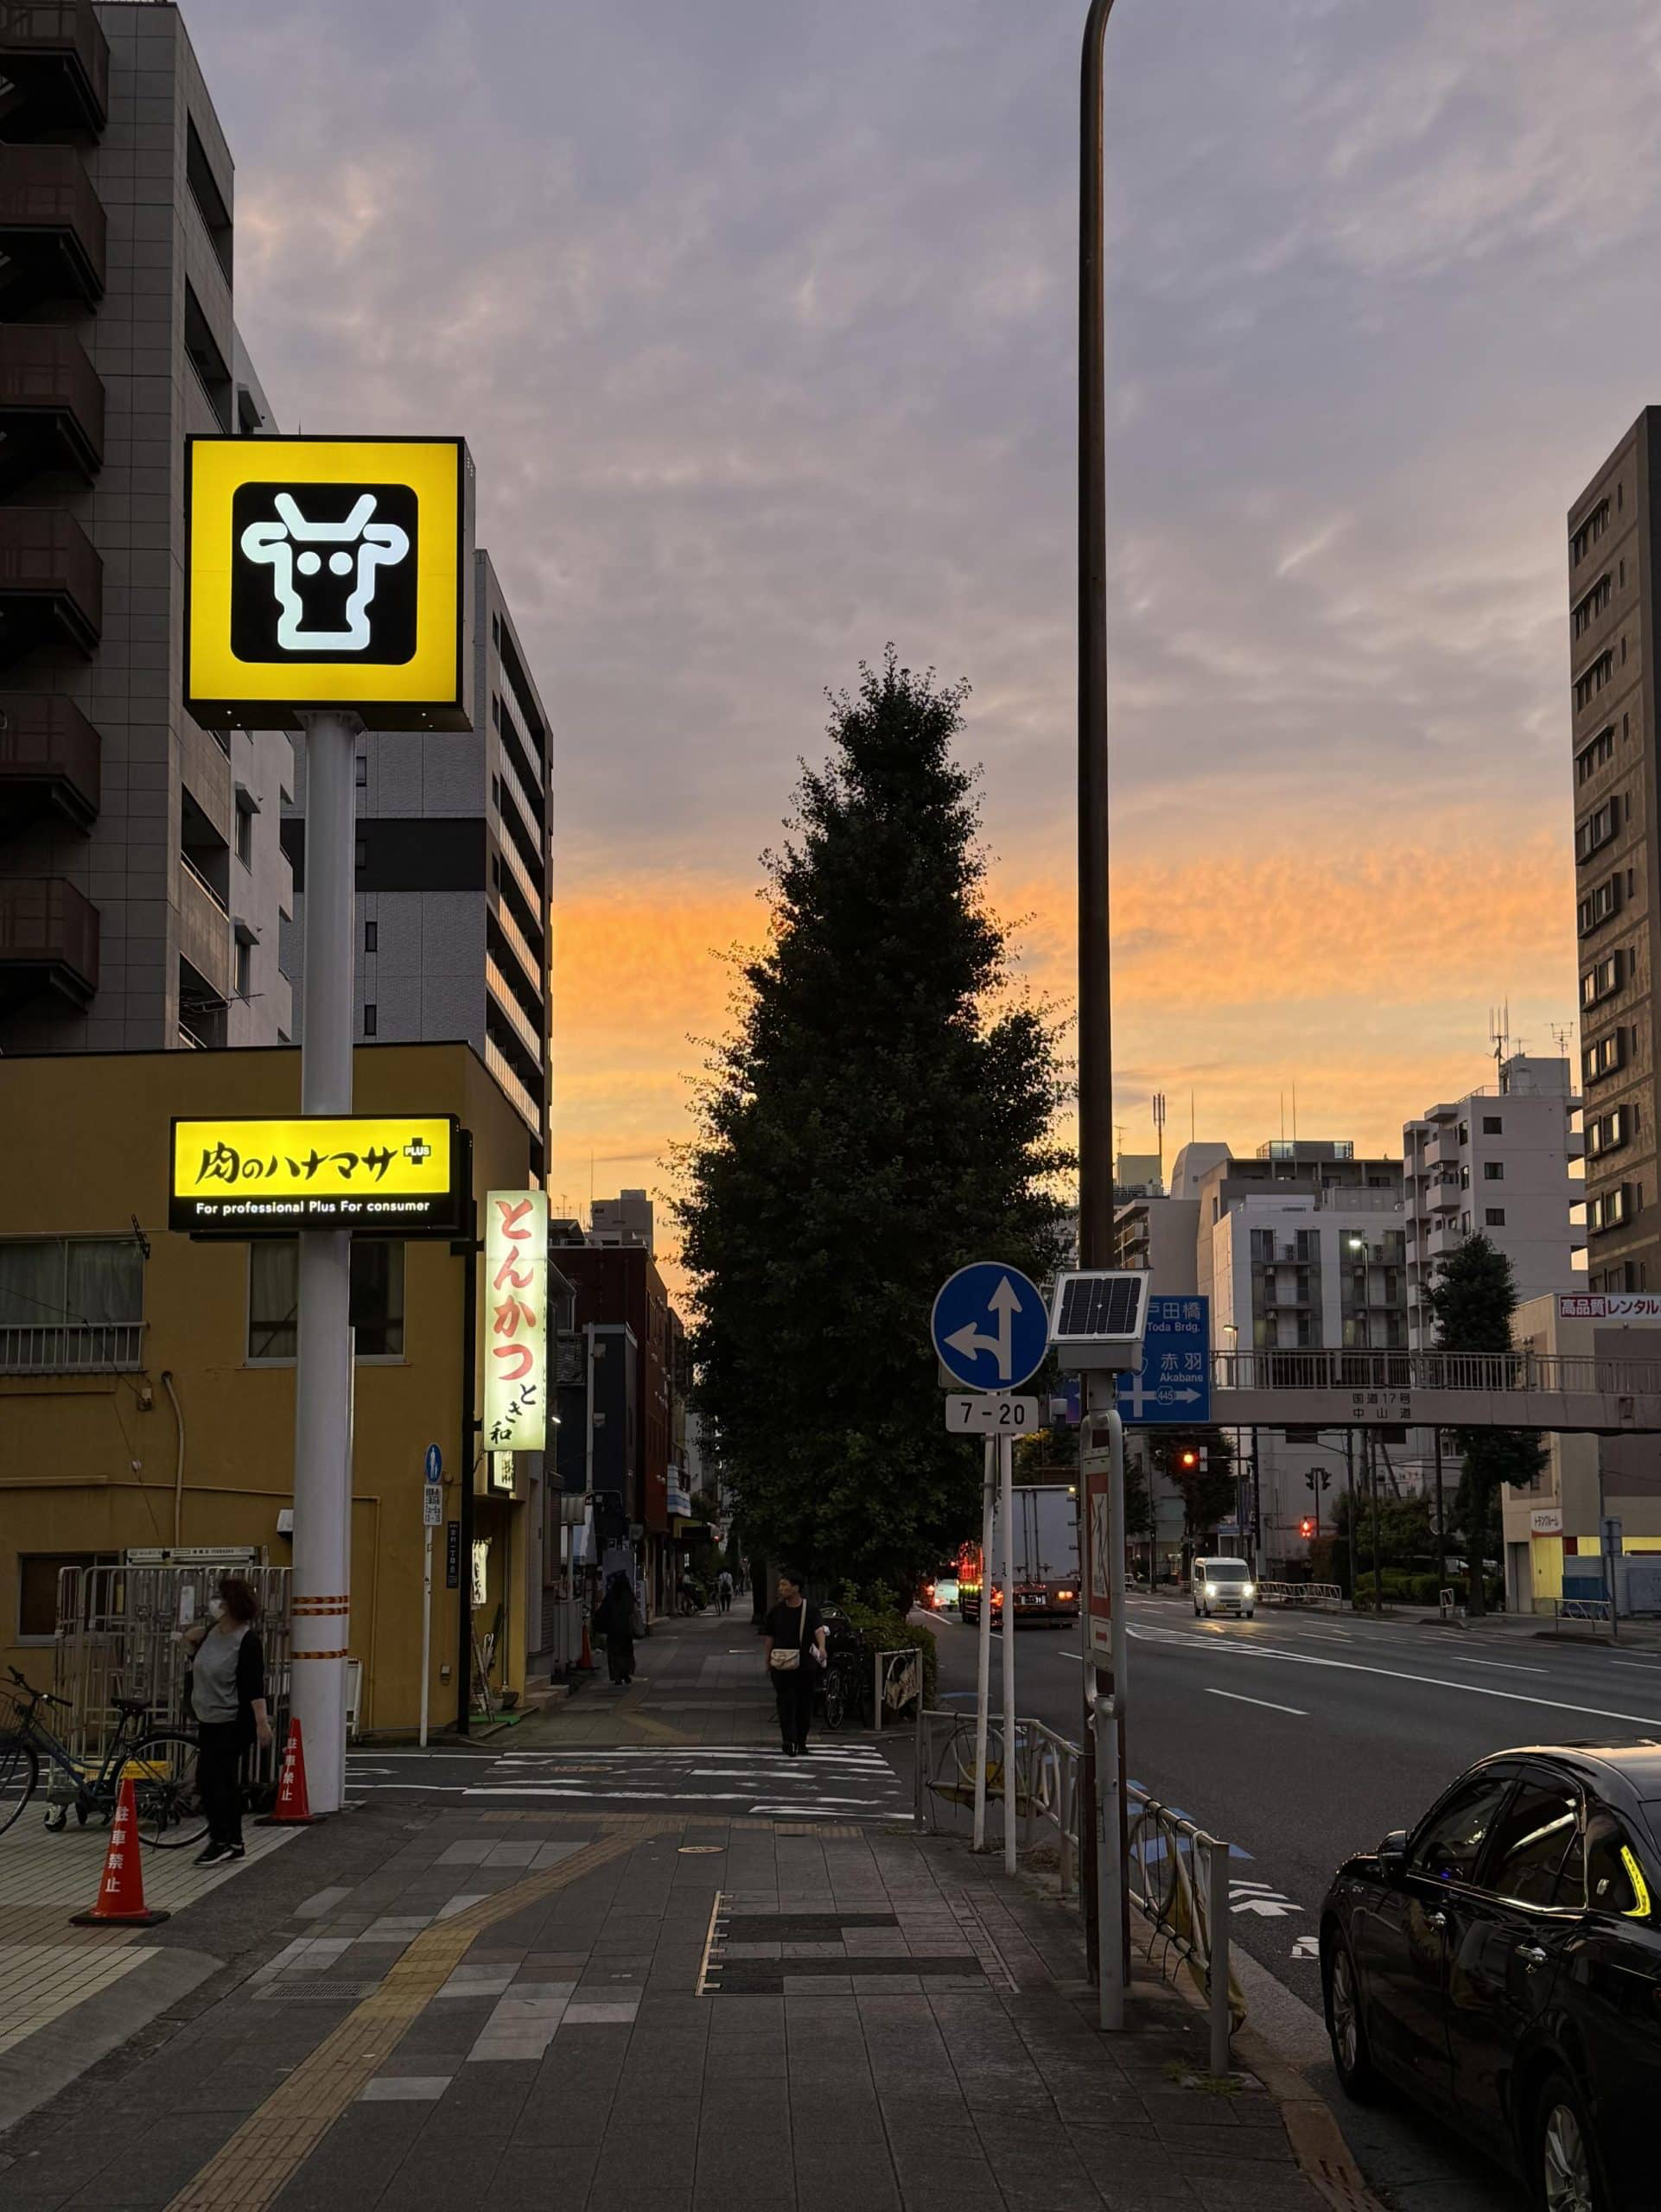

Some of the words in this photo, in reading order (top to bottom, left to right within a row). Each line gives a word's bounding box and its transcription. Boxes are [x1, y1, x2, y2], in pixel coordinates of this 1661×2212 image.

[404, 1146, 430, 1156] PLUS
[195, 1141, 398, 1184] 肉のハナマサ
[196, 1202, 218, 1214] For
[223, 1200, 304, 1215] professional
[309, 1200, 336, 1213] Plus
[340, 1200, 363, 1212] For
[366, 1200, 430, 1211] consumer
[493, 1198, 537, 1381] とんかつ
[1562, 1299, 1661, 1316] 高品質レンタル
[1148, 1322, 1171, 1332] Toda
[1174, 1322, 1200, 1333] Brdg.
[1161, 1353, 1202, 1370] 赤羽
[1160, 1374, 1203, 1382] Akabane
[1158, 1390, 1173, 1401] 445
[1352, 1393, 1410, 1404] 国道17号
[490, 1383, 537, 1444] とき和
[960, 1402, 1024, 1425] 7-20
[1352, 1408, 1410, 1419] 中山道
[281, 1738, 297, 1801] 駐車禁止
[105, 1806, 130, 1893] 駐車禁止
